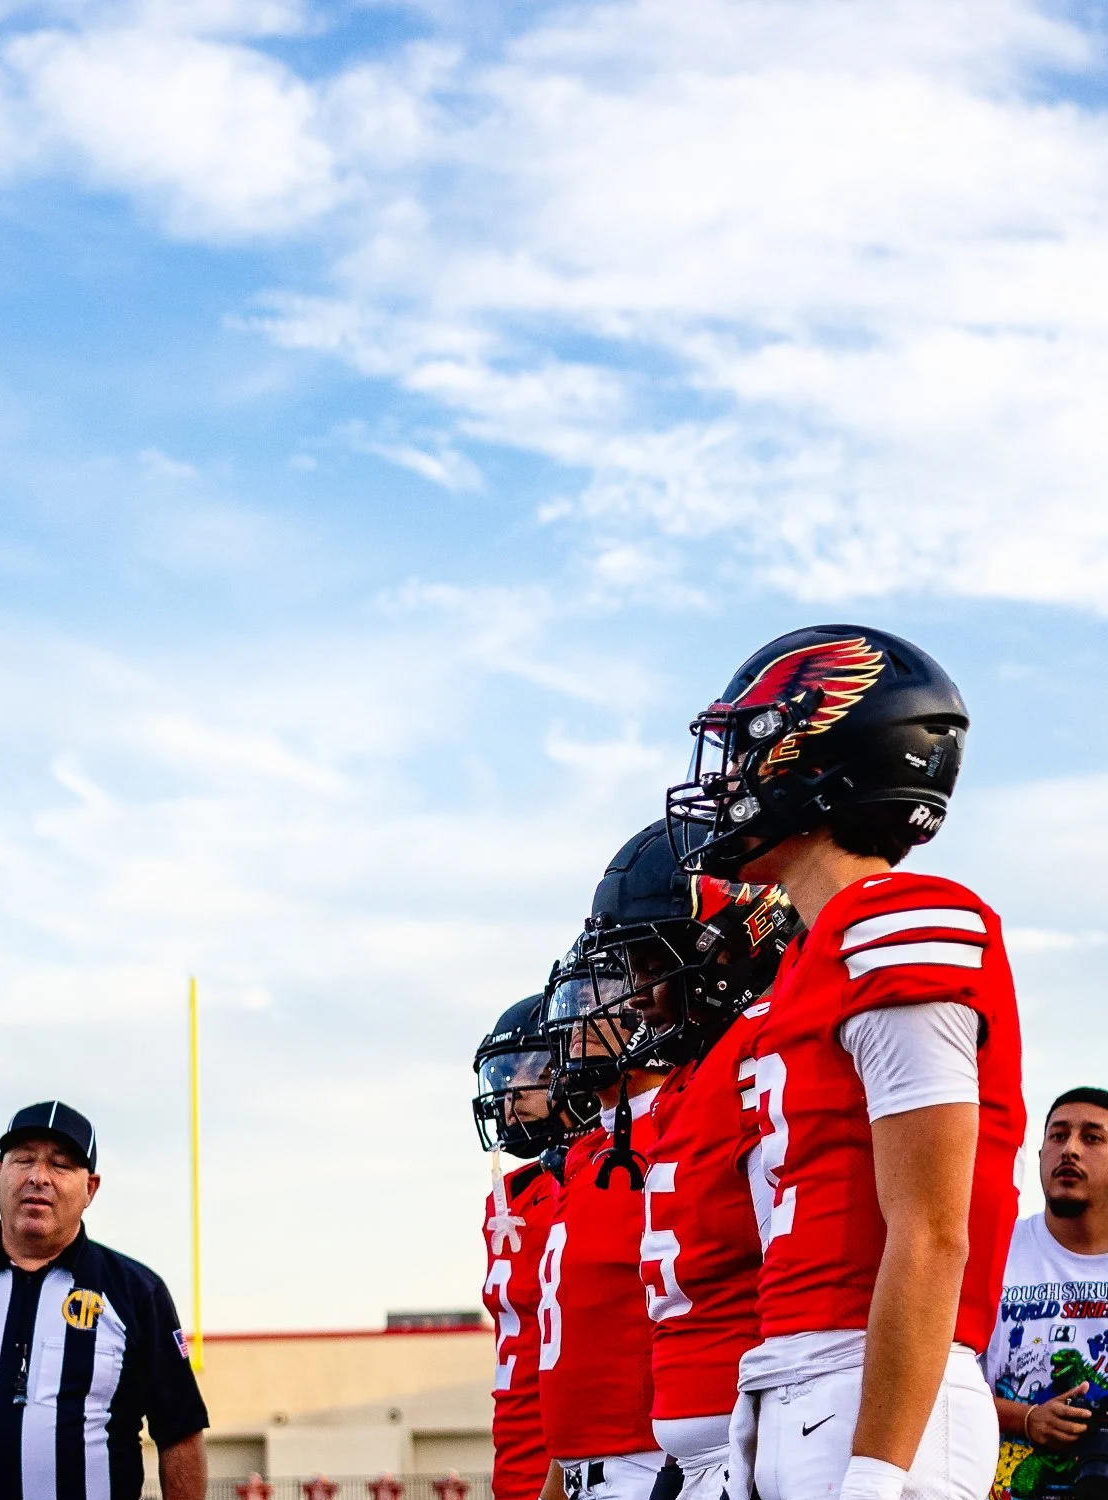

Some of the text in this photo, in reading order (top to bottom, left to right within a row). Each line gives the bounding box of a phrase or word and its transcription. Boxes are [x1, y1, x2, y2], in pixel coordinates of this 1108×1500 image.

[743, 902, 775, 947] E
[755, 1053, 798, 1245] 2
[485, 1259, 521, 1390] 2
